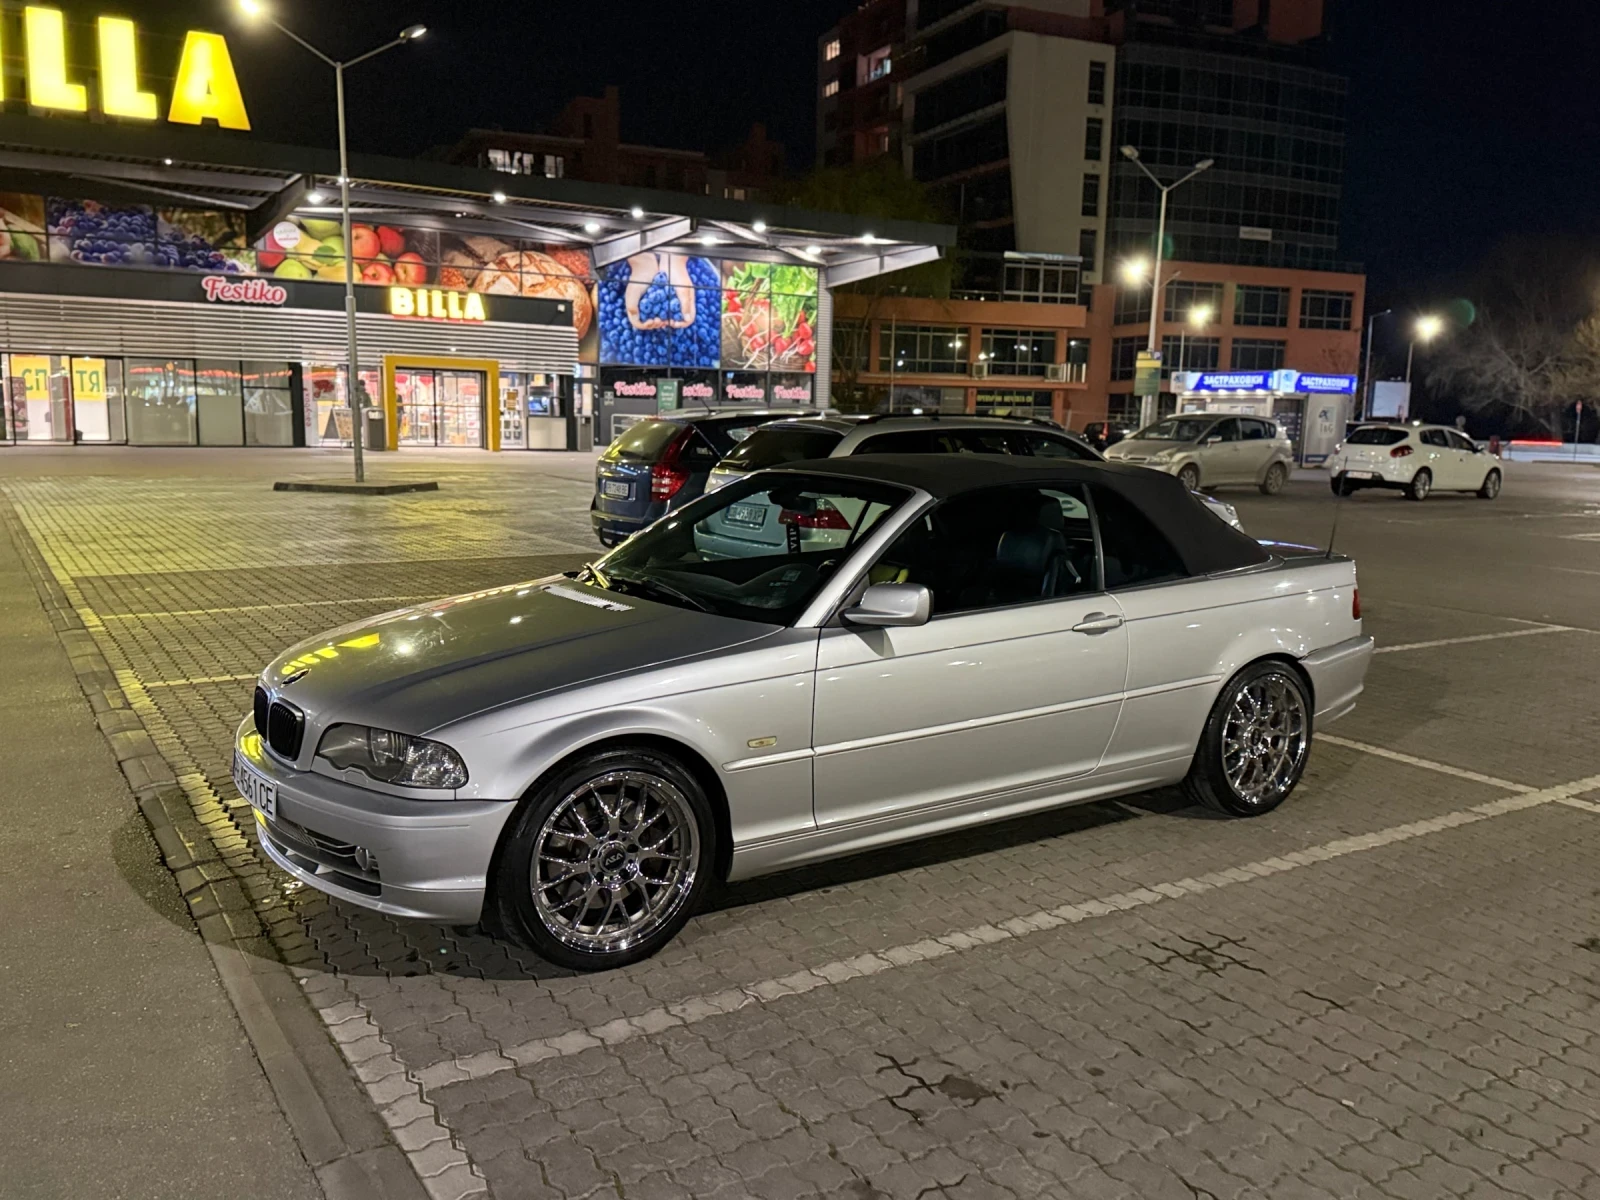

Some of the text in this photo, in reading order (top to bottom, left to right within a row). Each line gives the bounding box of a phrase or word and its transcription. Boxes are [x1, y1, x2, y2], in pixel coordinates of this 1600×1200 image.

[0, 6, 250, 130] LLA
[202, 276, 287, 305] Festiko
[390, 286, 486, 322] BILLA
[1203, 374, 1264, 386] ЗАСТРАХОВКИ
